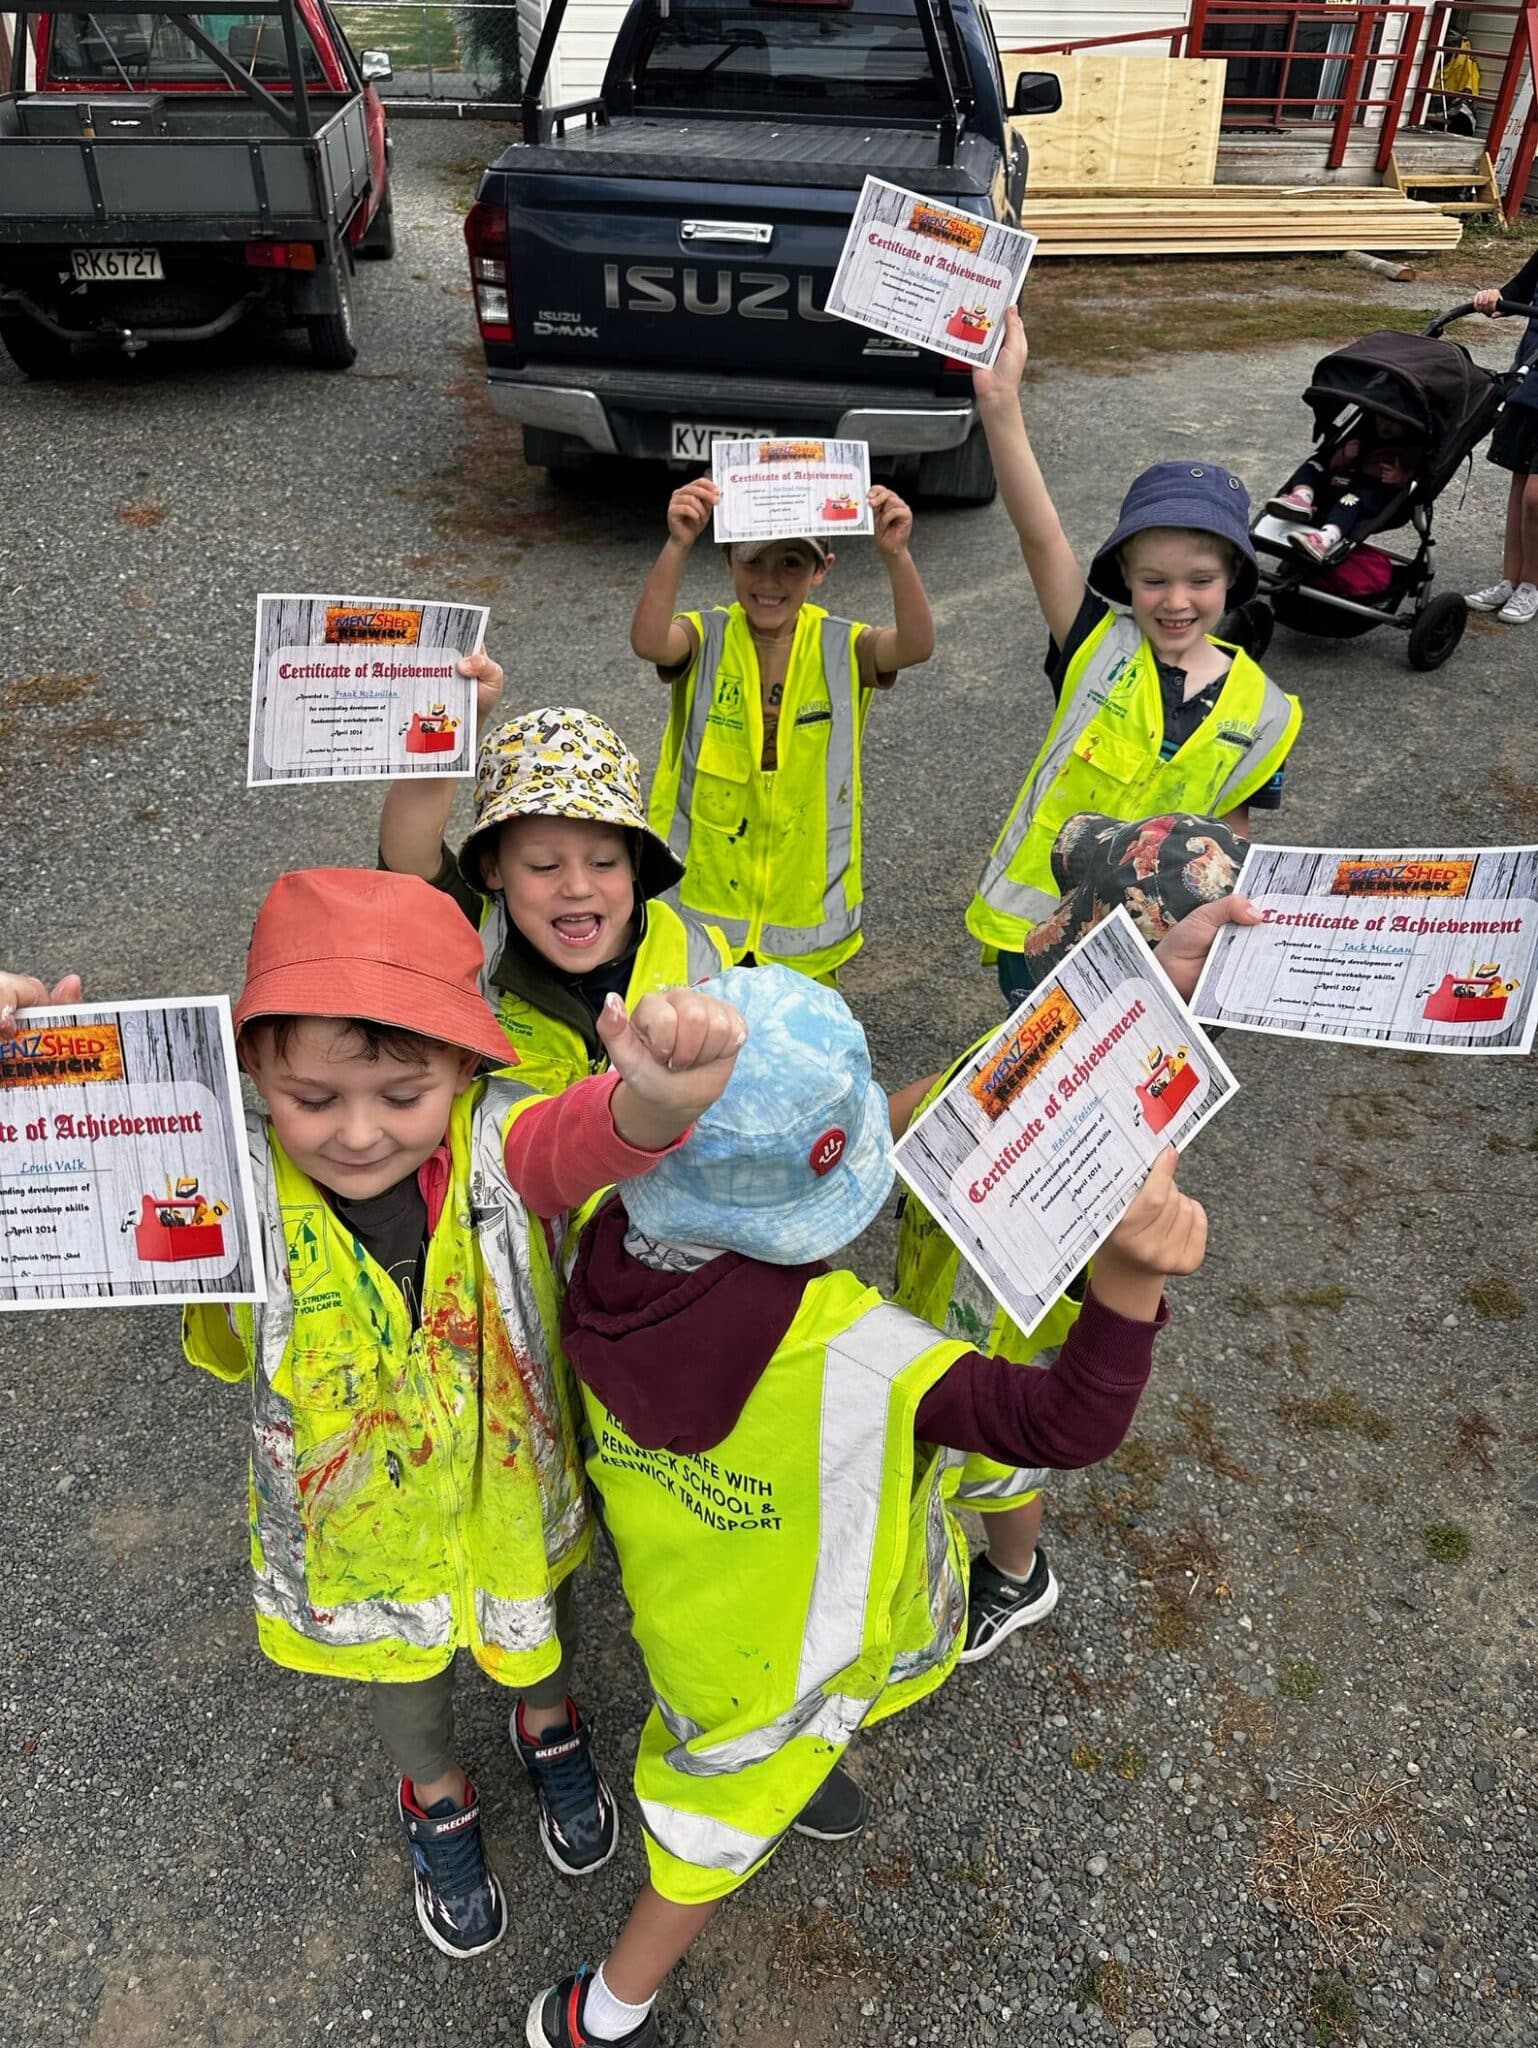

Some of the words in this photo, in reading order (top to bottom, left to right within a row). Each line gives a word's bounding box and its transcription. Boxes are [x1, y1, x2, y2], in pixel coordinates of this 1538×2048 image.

[74, 252, 159, 277] RK6727
[868, 232, 922, 262] Certificate
[923, 252, 936, 266] of
[935, 256, 1003, 290] Achievement
[538, 309, 581, 322] ISUZU
[532, 321, 599, 338] D-MAX
[730, 473, 779, 484] Certificate
[782, 471, 792, 481] of
[794, 470, 854, 481] Achievement
[335, 613, 411, 629] MENZSHED
[279, 663, 350, 680] Certificate
[355, 663, 369, 678] of
[372, 662, 453, 680] Achievement
[1348, 864, 1458, 881] MENZSHED
[1262, 909, 1360, 931] Certificate
[1366, 915, 1385, 932] of
[1389, 915, 1523, 936] Achievement
[1347, 958, 1391, 968] development
[1313, 982, 1339, 991] April
[0, 1033, 104, 1059] ENZSHED
[985, 1006, 1062, 1094] MENZSHED
[0, 1058, 102, 1077] ENWICK
[997, 1019, 1068, 1100] RENWICK
[968, 1118, 1045, 1203] Certificate
[1045, 1095, 1062, 1120] of
[1057, 999, 1147, 1102] Achievement
[25, 1116, 48, 1142] of
[54, 1110, 203, 1142] Achievement
[1030, 1191, 1040, 1203] for
[1097, 1113, 1105, 1125] of
[20, 1162, 52, 1174] Louis
[1034, 1167, 1042, 1176] to
[28, 1184, 78, 1195] development
[81, 1183, 90, 1192] of
[1071, 1179, 1089, 1201] April
[21, 1205, 62, 1215] workshop
[65, 1203, 89, 1212] skills
[5, 1226, 33, 1238] April
[302, 1291, 341, 1306] STRENGTH
[300, 1306, 315, 1315] YOU
[316, 1301, 331, 1311] CAN
[602, 1430, 678, 1473] RENWICK
[683, 1464, 754, 1514] SCHOOL
[761, 1503, 775, 1513] &
[600, 1453, 675, 1496] RENWICK
[679, 1486, 782, 1531] TRANSPORT
[724, 1470, 773, 1496] WITH
